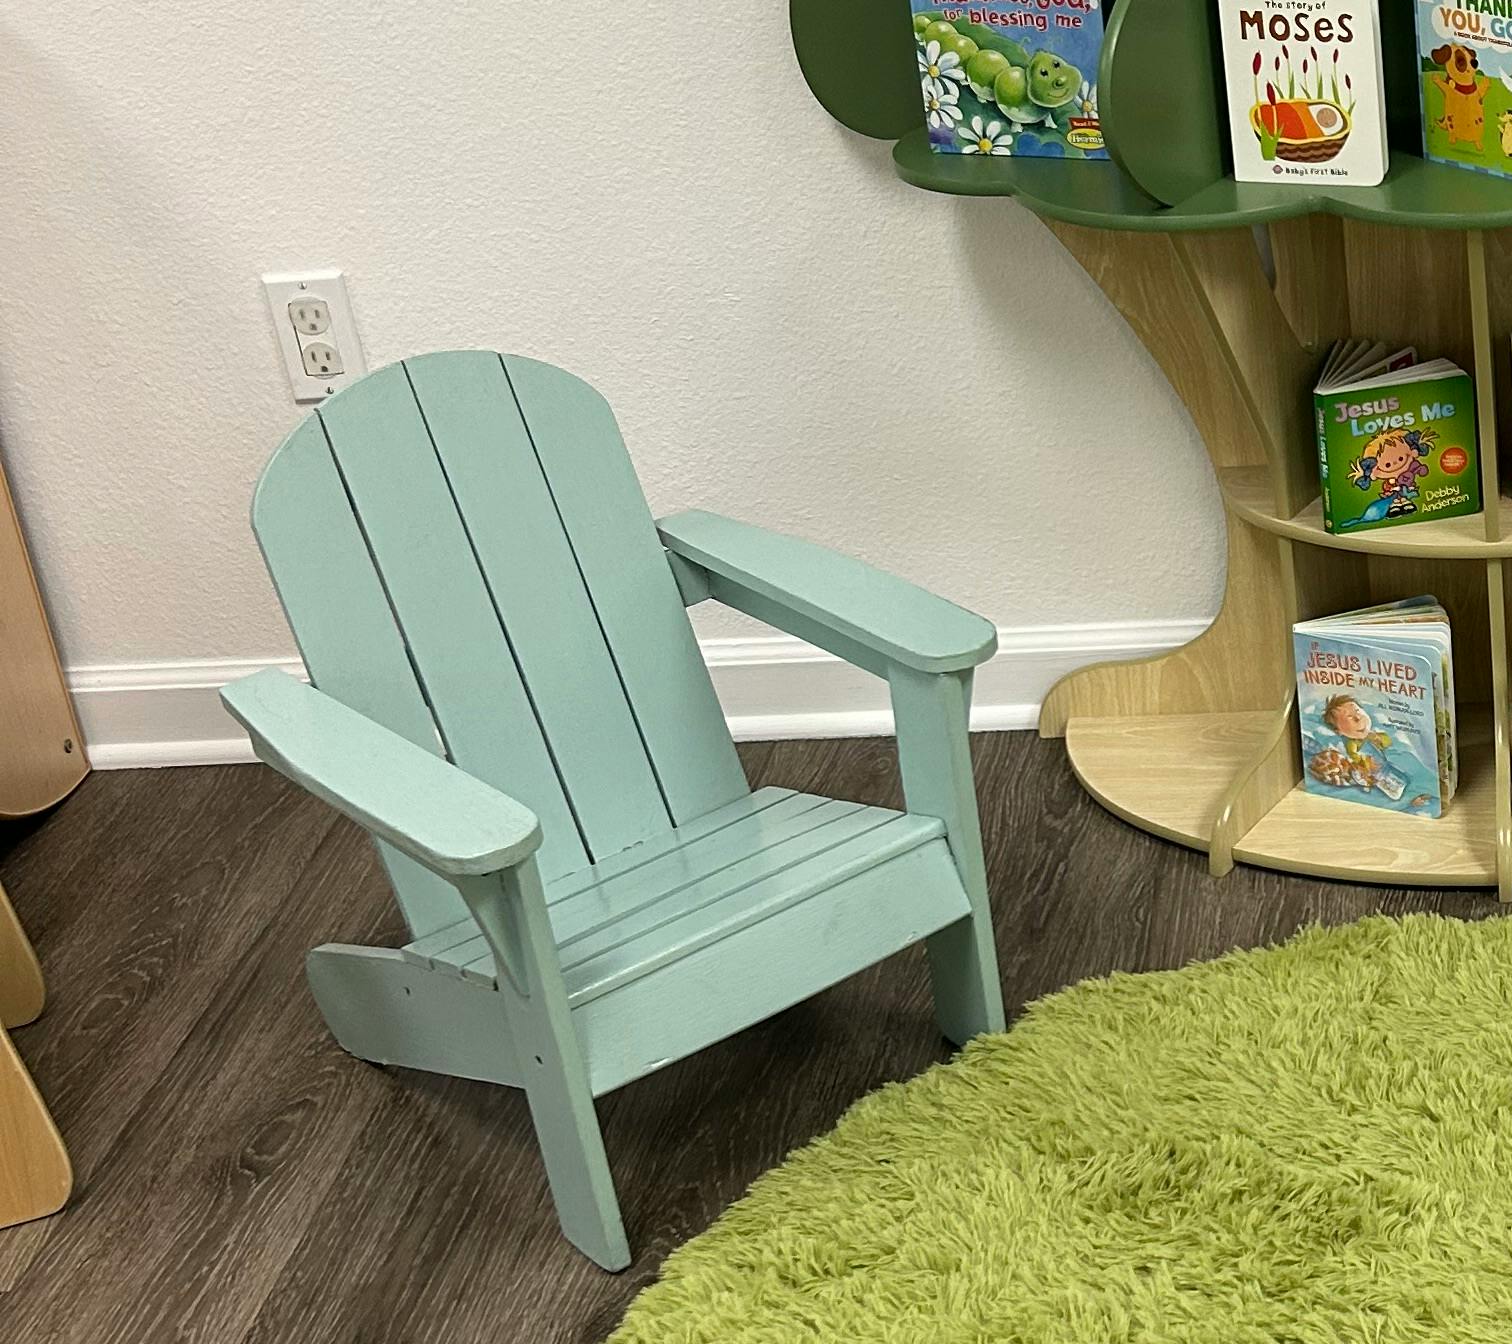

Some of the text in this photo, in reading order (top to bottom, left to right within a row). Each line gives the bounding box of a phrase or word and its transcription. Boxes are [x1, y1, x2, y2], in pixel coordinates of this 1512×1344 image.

[1265, 0, 1283, 9] The
[1315, 0, 1326, 9] of
[943, 8, 1082, 31] for blessing me
[1440, 7, 1485, 36] YOU,
[1334, 397, 1400, 423] Jesus
[1351, 402, 1455, 436] Loves Me
[1421, 494, 1470, 513] Anderson
[1425, 485, 1460, 501] Debby
[1307, 652, 1417, 681] JESUS LIVED
[1303, 669, 1427, 700] INSIDE MY HEART
